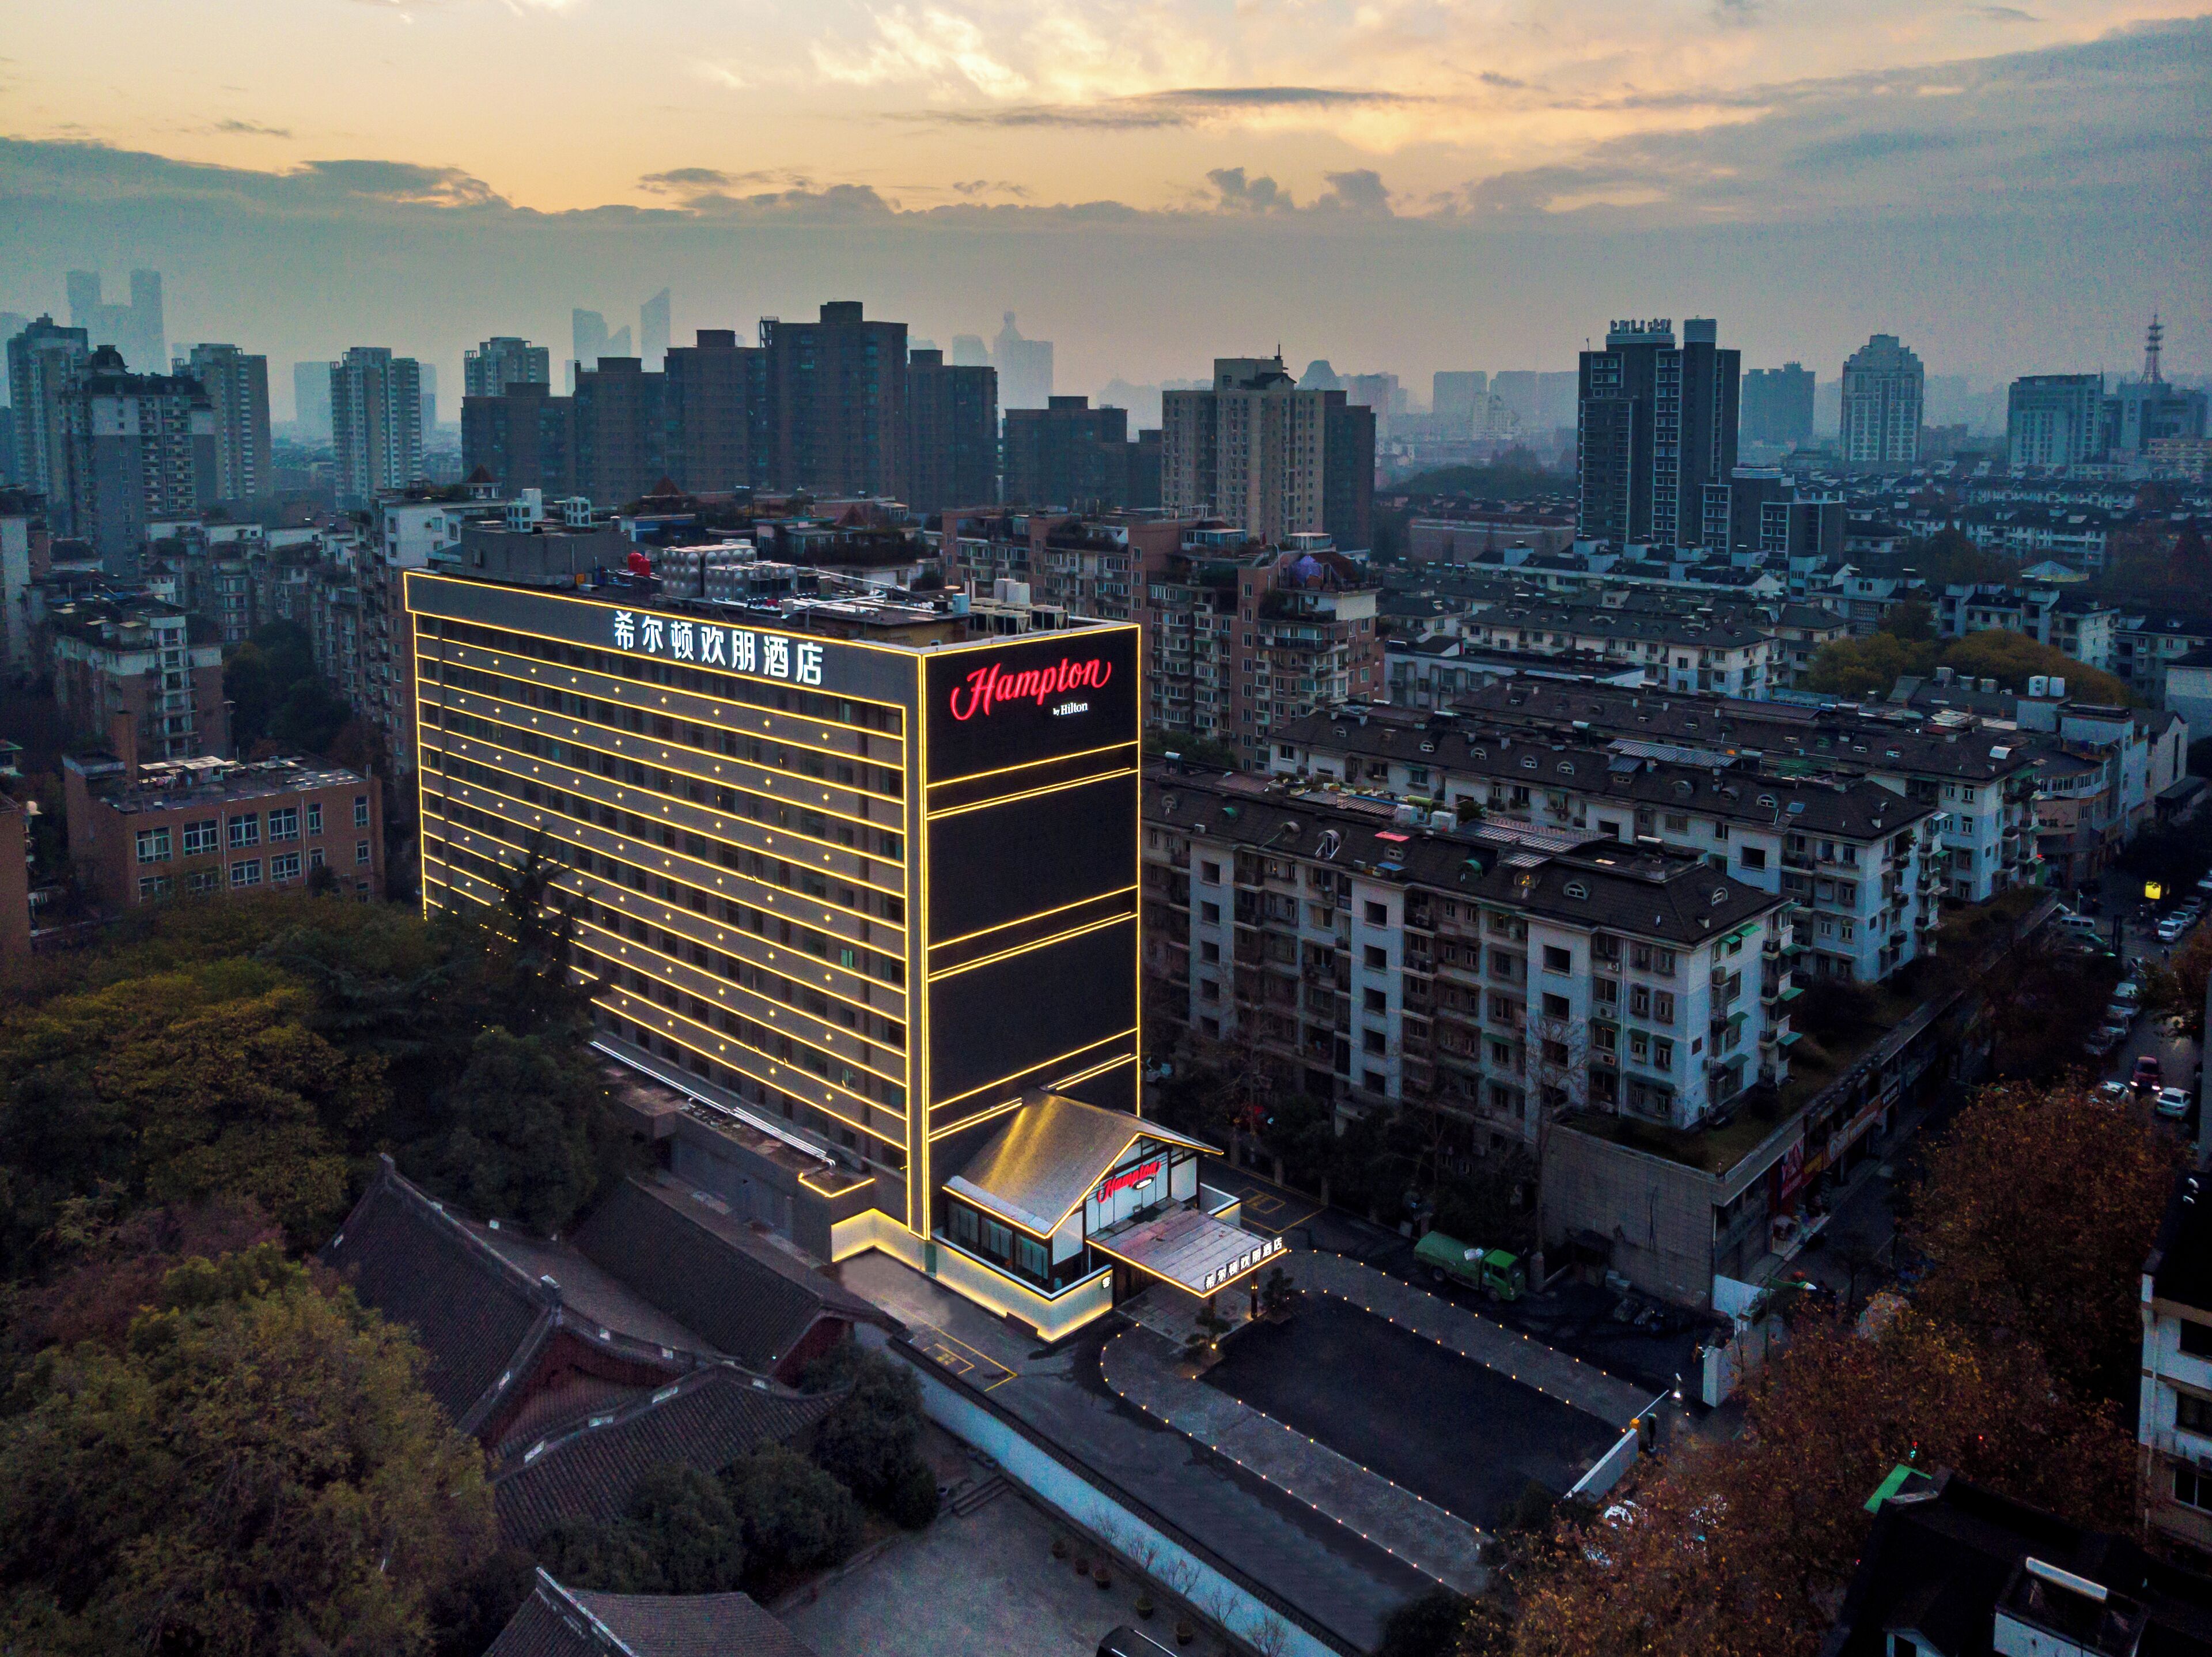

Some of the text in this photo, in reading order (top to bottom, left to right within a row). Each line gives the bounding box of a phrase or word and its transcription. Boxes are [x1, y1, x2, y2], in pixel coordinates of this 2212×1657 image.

[614, 611, 823, 685] 希尔顿欢朋酒店
[951, 659, 1112, 720] Hampton
[1060, 702, 1088, 715] Hilton
[1097, 1162, 1161, 1203] Hampton
